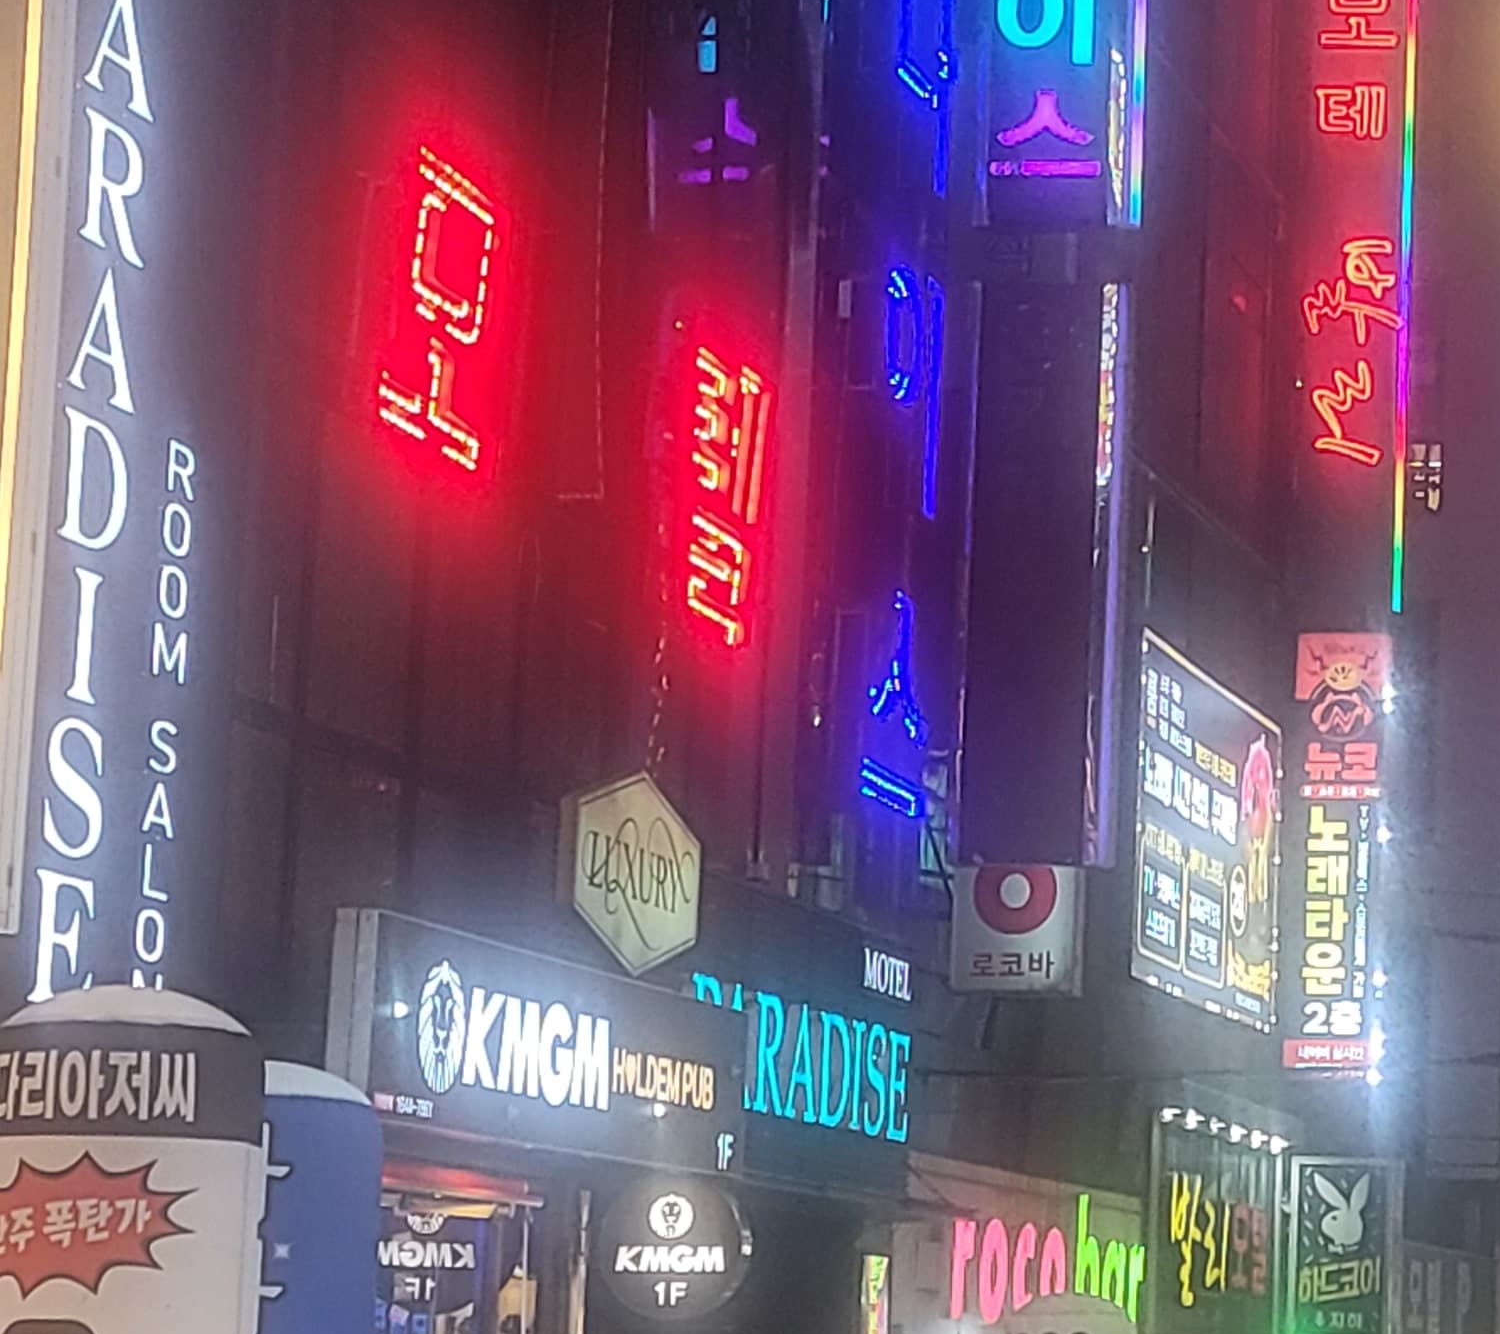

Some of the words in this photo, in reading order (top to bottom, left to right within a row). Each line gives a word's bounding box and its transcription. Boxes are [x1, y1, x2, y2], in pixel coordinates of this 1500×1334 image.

[151, 437, 197, 686] ROOM
[1301, 804, 1349, 997] 노래타운
[863, 947, 912, 1002] MOTEL
[968, 949, 1056, 980] 로코바
[1302, 999, 1363, 1036] 2층
[461, 986, 611, 1112] KMGM
[682, 1058, 714, 1111] PUB
[715, 1133, 735, 1171] 1F
[42, 1193, 152, 1248] 폭탄가
[1168, 1171, 1231, 1308] 발리
[614, 1245, 726, 1273] KMGM
[654, 1281, 688, 1307] 1F
